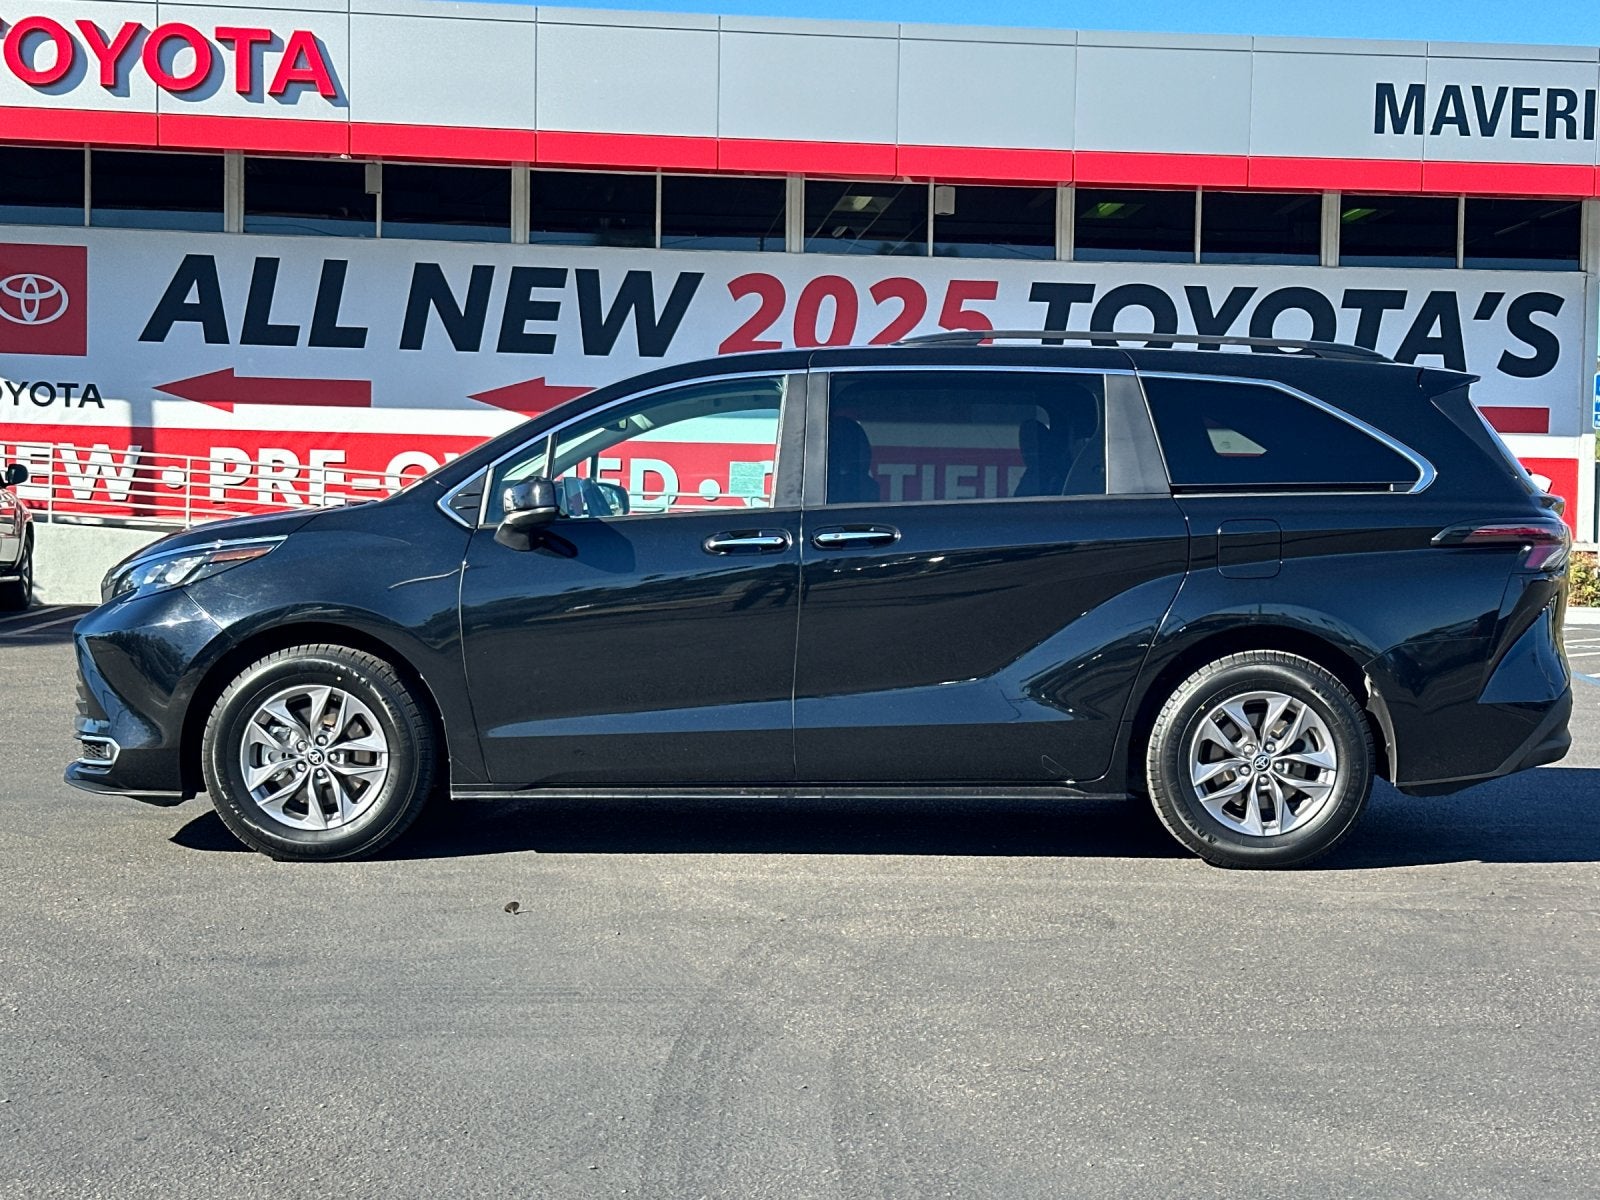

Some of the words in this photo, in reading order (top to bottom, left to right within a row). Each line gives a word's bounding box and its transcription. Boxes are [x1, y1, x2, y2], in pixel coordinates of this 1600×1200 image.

[0, 15, 337, 99] OYOTA
[1374, 82, 1597, 141] MAVERI
[138, 253, 369, 349] ALL
[399, 262, 705, 358] NEW
[718, 272, 999, 355] 2025
[1029, 281, 1565, 378] TOYOTA'S
[0, 381, 105, 409] YOTA
[0, 442, 143, 501] EW
